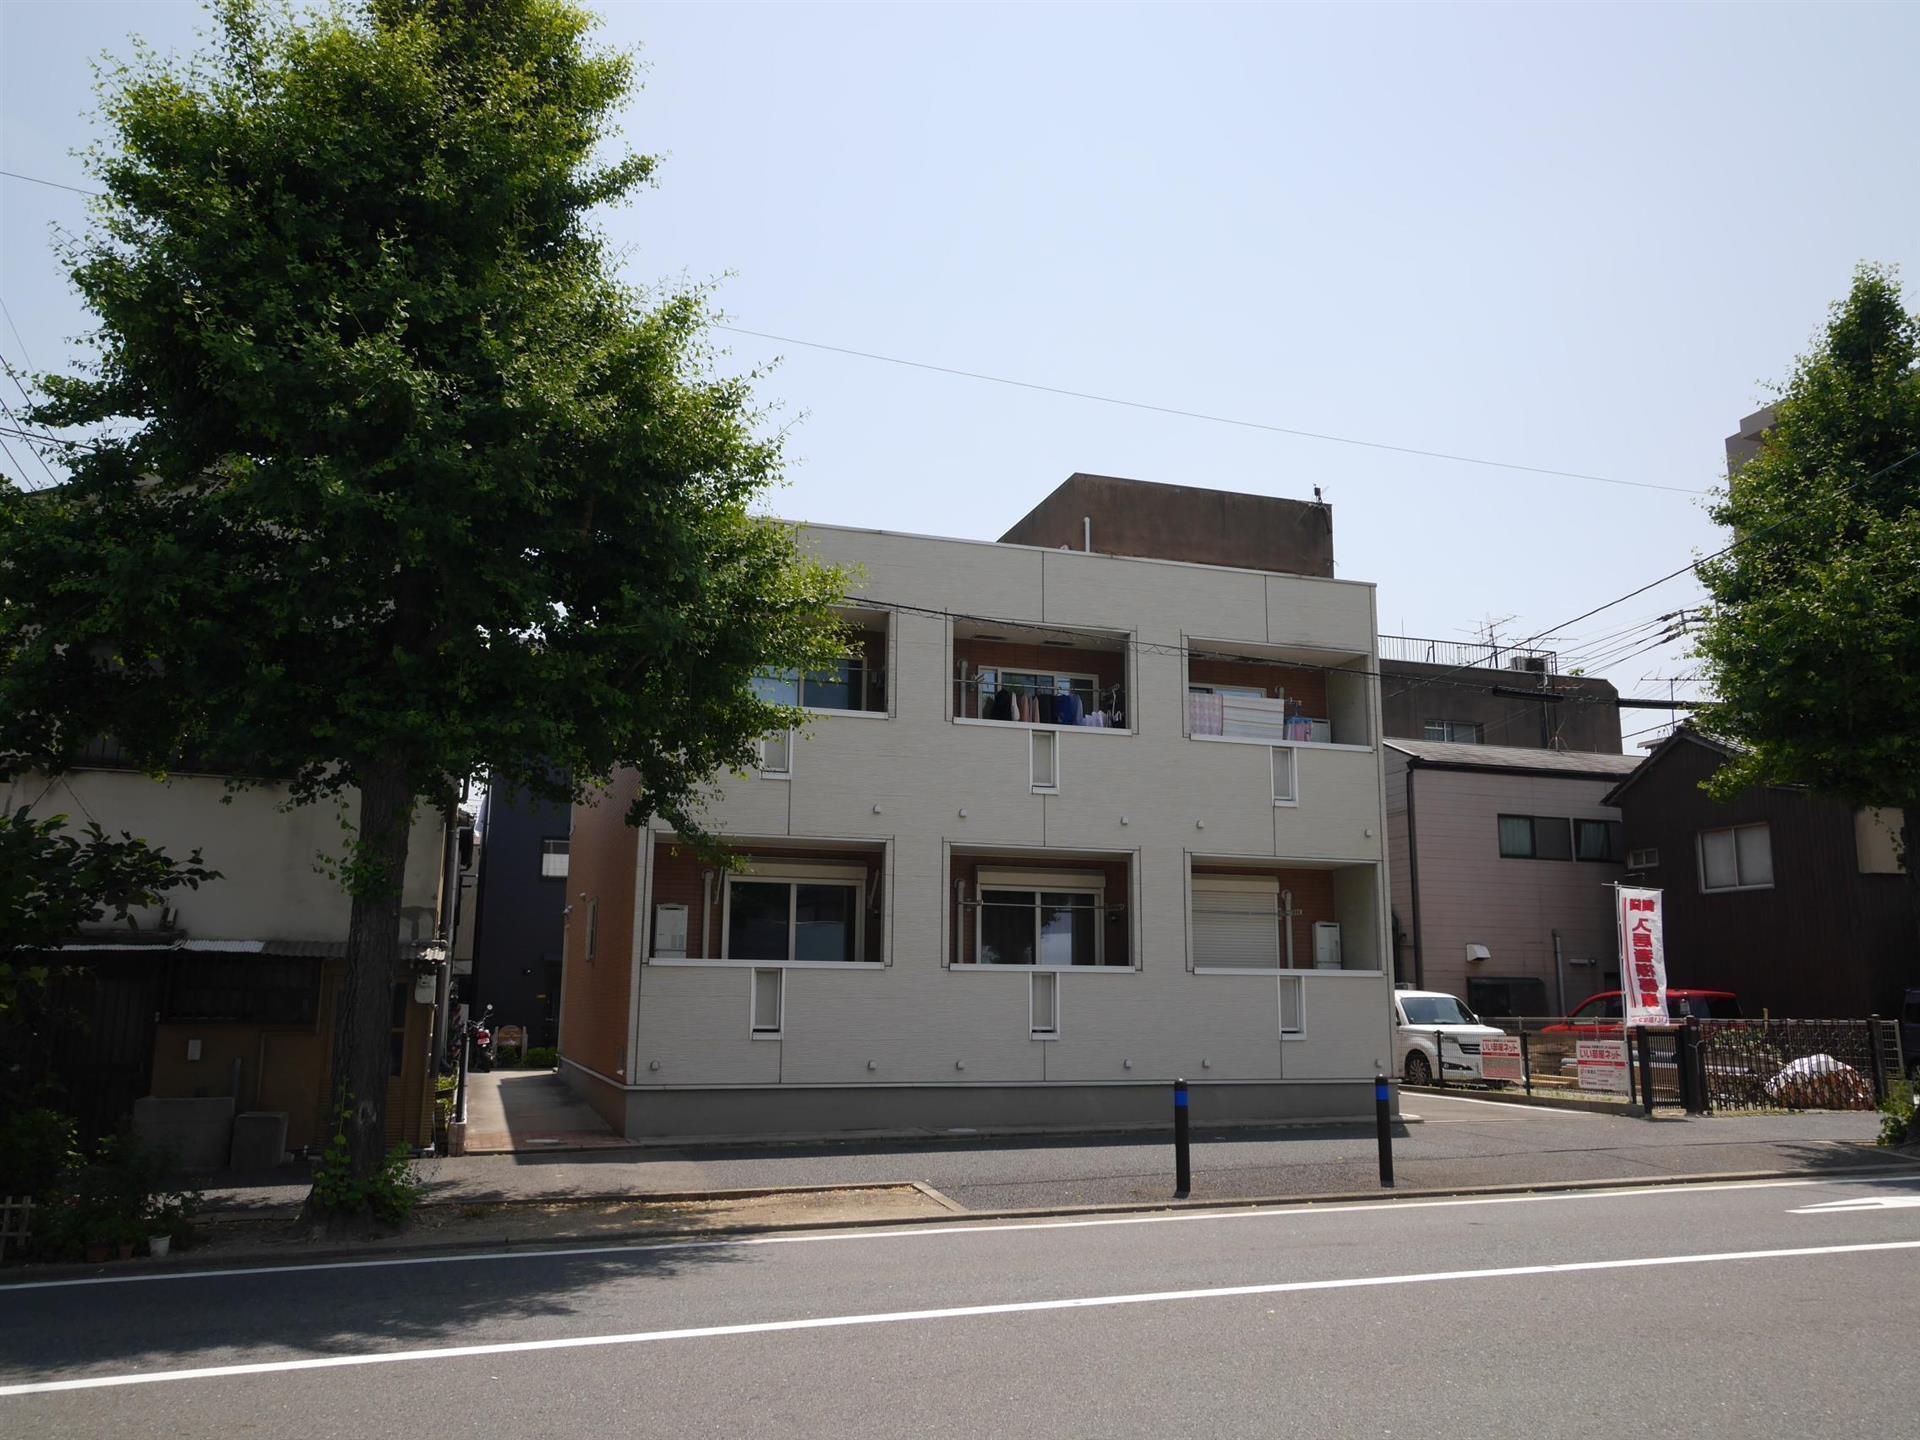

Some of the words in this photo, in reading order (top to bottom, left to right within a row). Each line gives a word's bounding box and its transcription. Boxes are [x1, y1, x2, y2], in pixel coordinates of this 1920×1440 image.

[1482, 1042, 1518, 1052] いい部屋ネット
[1579, 1049, 1621, 1060] いい部屋ネット
